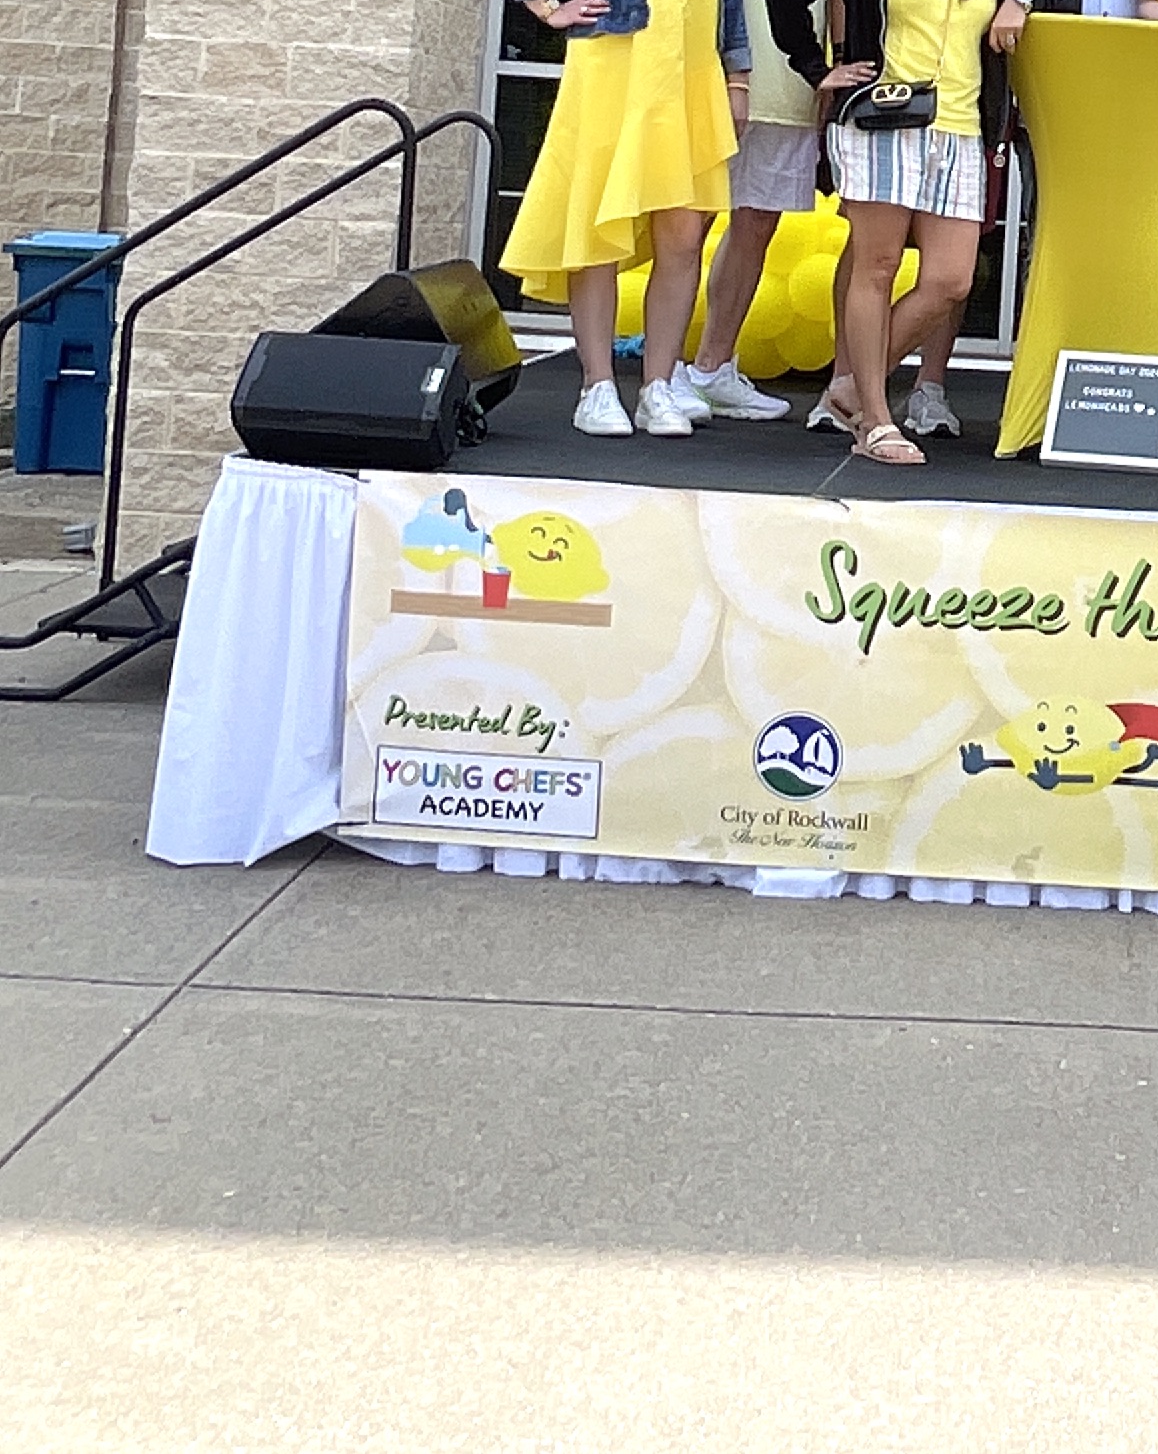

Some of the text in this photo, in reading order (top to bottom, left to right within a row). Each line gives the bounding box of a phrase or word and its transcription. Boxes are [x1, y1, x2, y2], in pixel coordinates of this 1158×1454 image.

[1068, 363, 1116, 376] LEMONADE
[1119, 365, 1137, 376] DAY
[1082, 386, 1133, 399] CONGRATS
[804, 539, 1069, 654] Squeeze
[385, 694, 571, 753] Presented By:
[382, 757, 484, 789] YOUNG
[418, 794, 545, 822] ACADEMY
[720, 804, 868, 832] City of Rockwall
